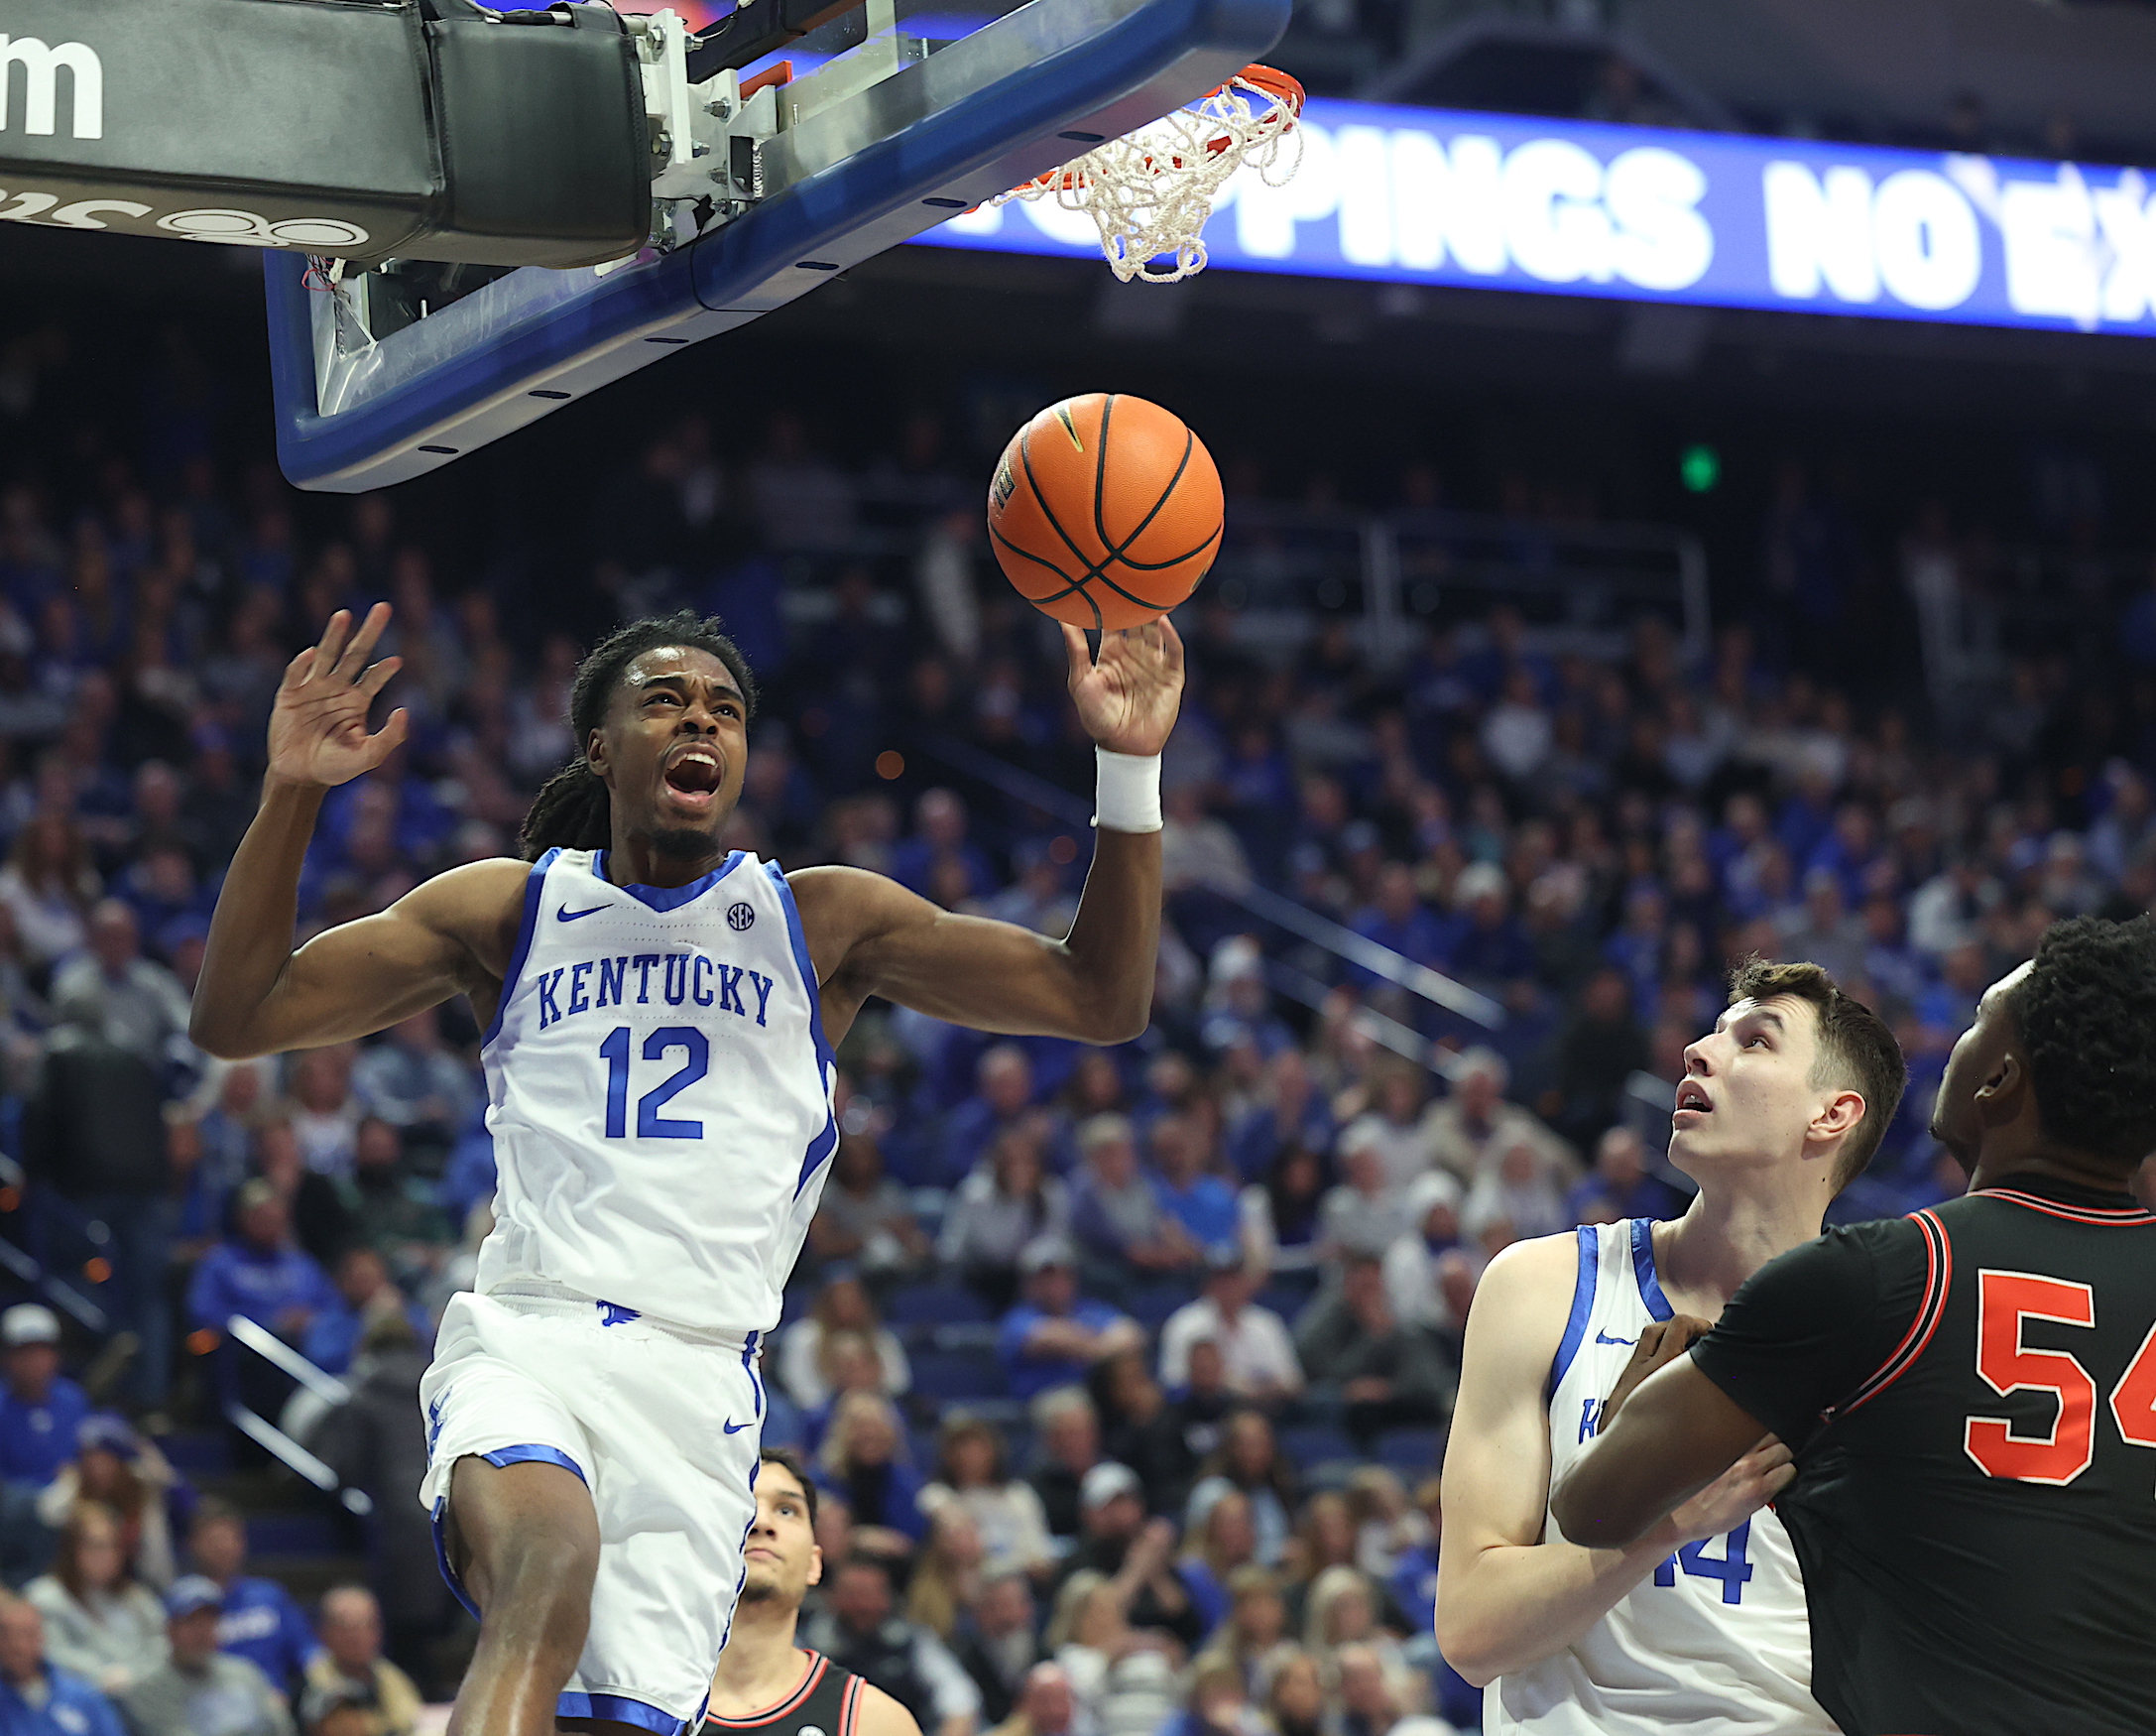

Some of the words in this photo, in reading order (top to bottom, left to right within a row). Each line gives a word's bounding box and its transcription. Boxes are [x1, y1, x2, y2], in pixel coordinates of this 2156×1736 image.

[945, 114, 1713, 291] PINGS
[1762, 160, 1981, 310] NO
[728, 903, 754, 930] SEC
[539, 954, 773, 1031] KENTUCKY
[599, 1026, 710, 1140] 12
[1653, 1516, 1754, 1605] 4
